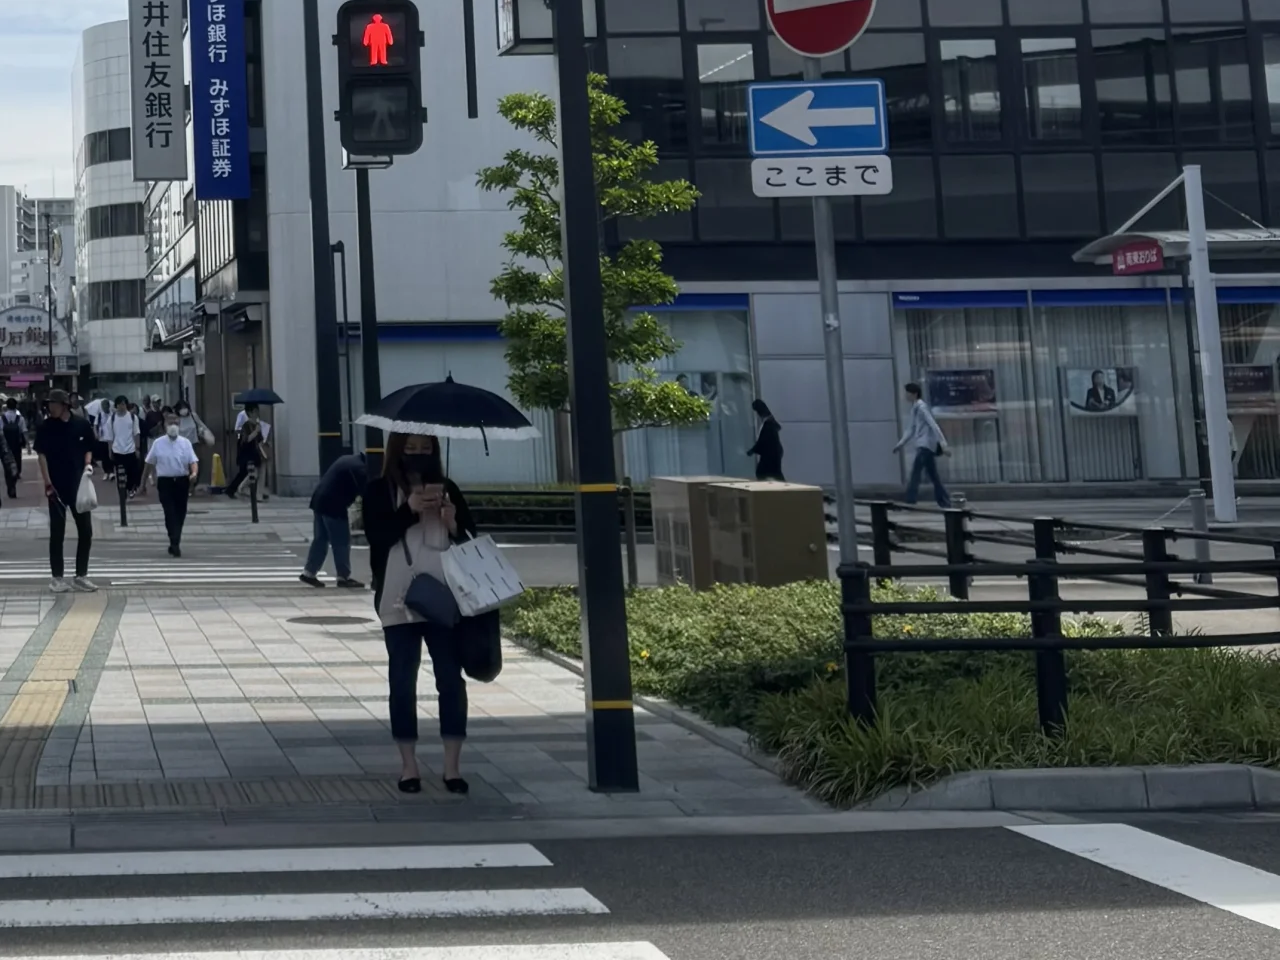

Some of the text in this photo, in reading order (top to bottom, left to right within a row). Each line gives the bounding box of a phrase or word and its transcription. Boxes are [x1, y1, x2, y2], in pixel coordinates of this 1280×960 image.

[209, 78, 233, 179] みずほ証券
[766, 165, 880, 187] ここまで
